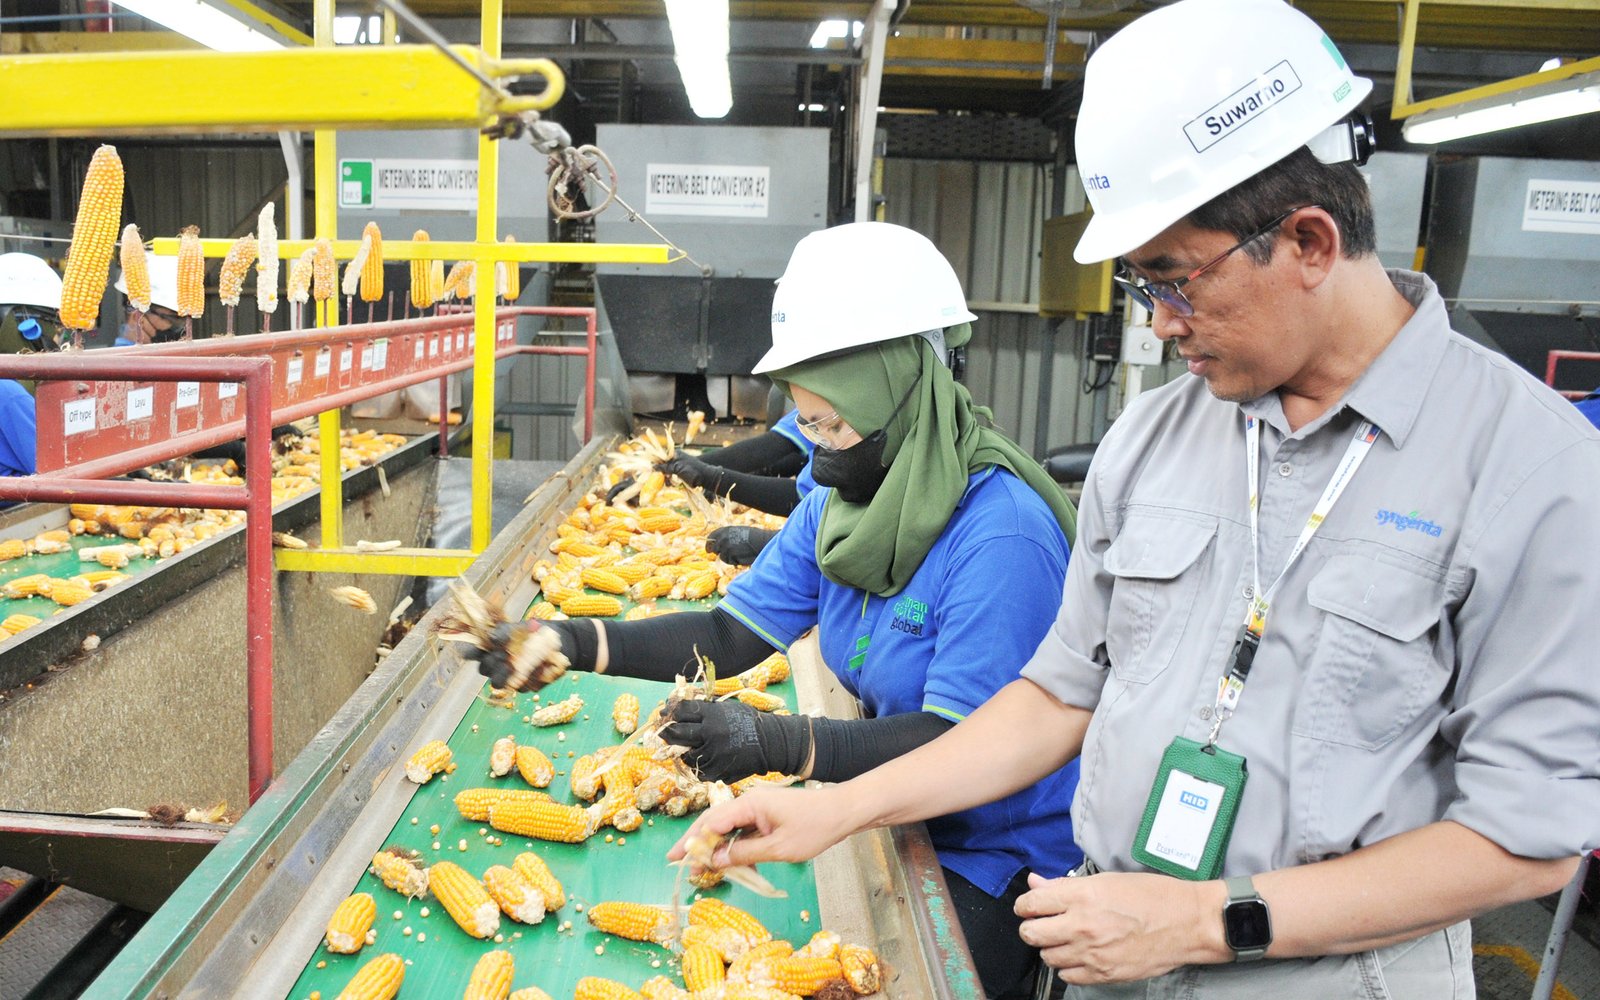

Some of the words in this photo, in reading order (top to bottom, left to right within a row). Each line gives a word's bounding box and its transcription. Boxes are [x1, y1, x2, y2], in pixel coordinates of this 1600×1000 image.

[1205, 78, 1285, 136] Suwarno
[379, 169, 417, 188] METERING
[418, 169, 435, 189] BELT
[650, 174, 689, 195] METERING
[691, 175, 710, 195] BELT
[711, 175, 754, 197] CONVEYOR
[756, 176, 766, 197] #2
[1529, 190, 1569, 211] METERING
[1569, 191, 1590, 213] BELT
[69, 411, 79, 423] Off
[80, 410, 92, 422] type
[1375, 508, 1443, 538] syngenta
[1180, 791, 1208, 810] HID
